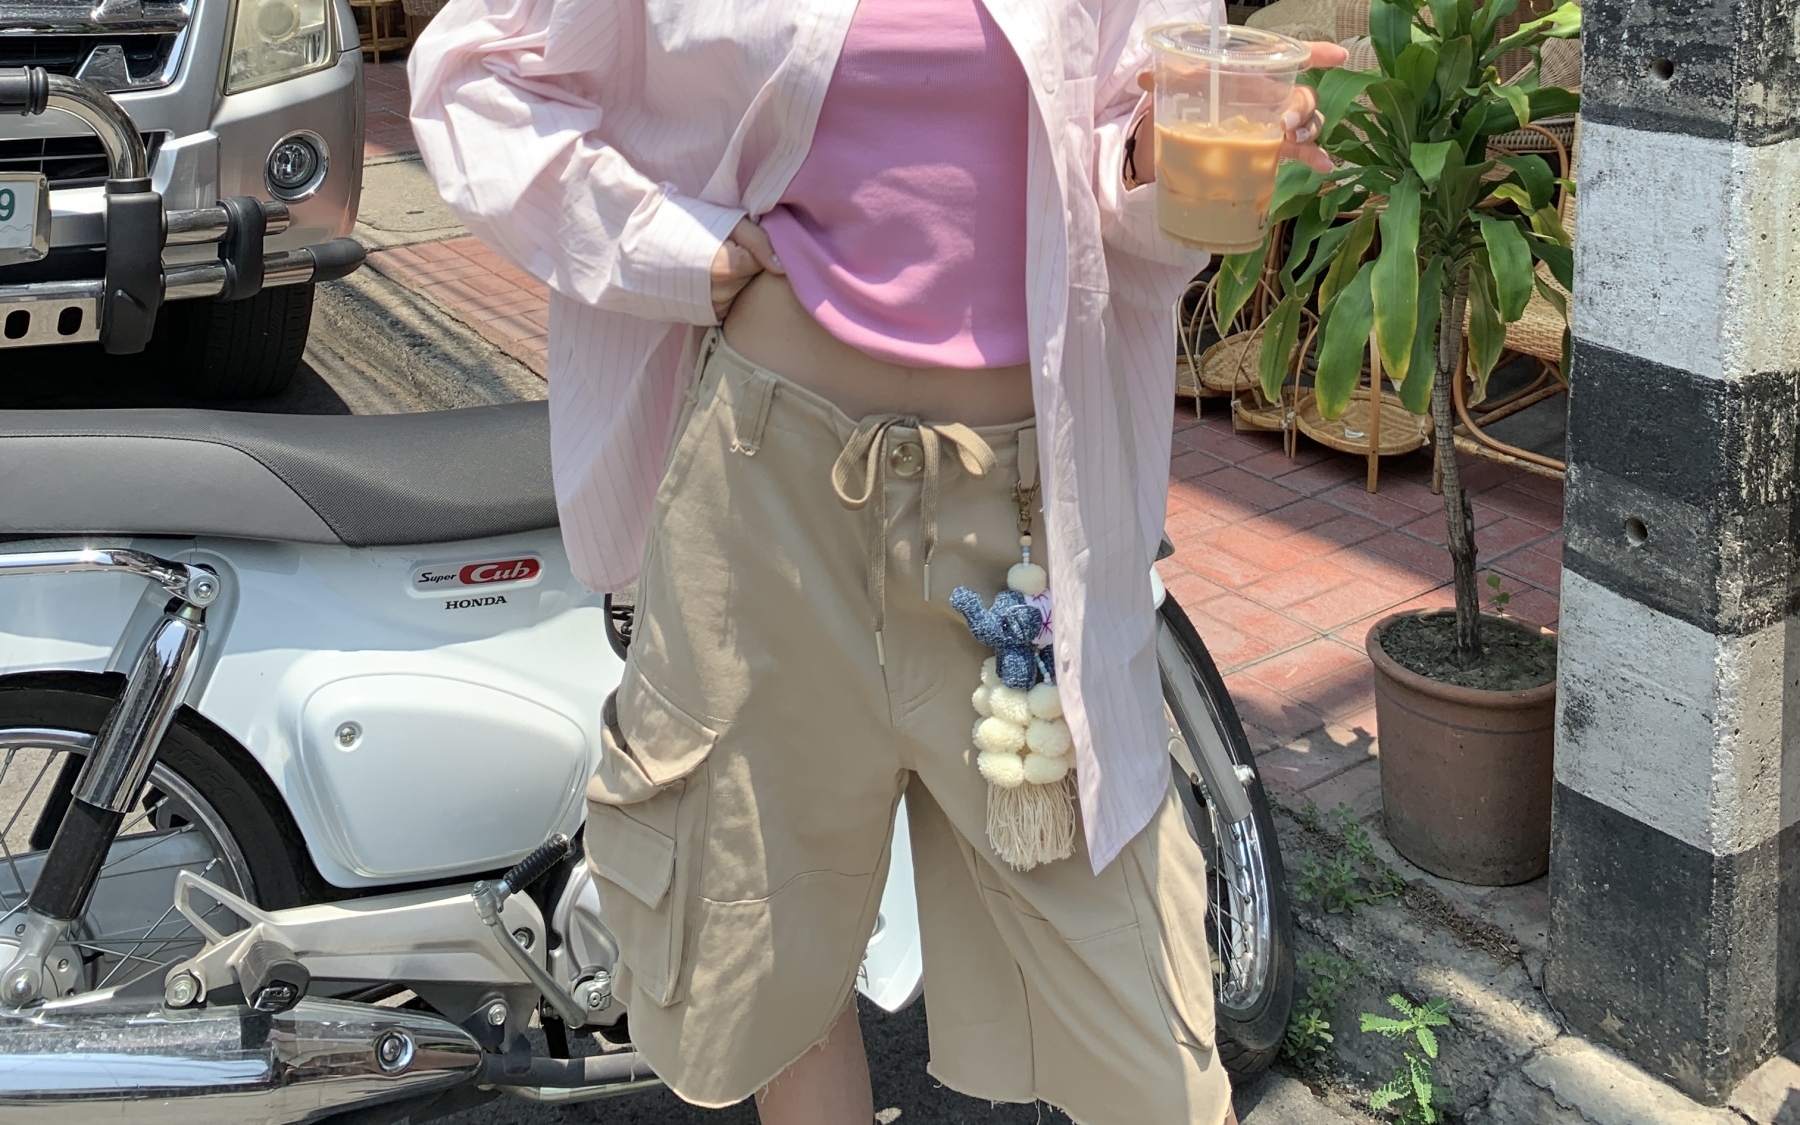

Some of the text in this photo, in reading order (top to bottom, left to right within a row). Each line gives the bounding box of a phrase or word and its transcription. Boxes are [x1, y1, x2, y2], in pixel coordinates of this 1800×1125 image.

[0, 188, 15, 221] 9
[418, 561, 530, 584] Super Cub
[445, 595, 508, 610] HONDA
